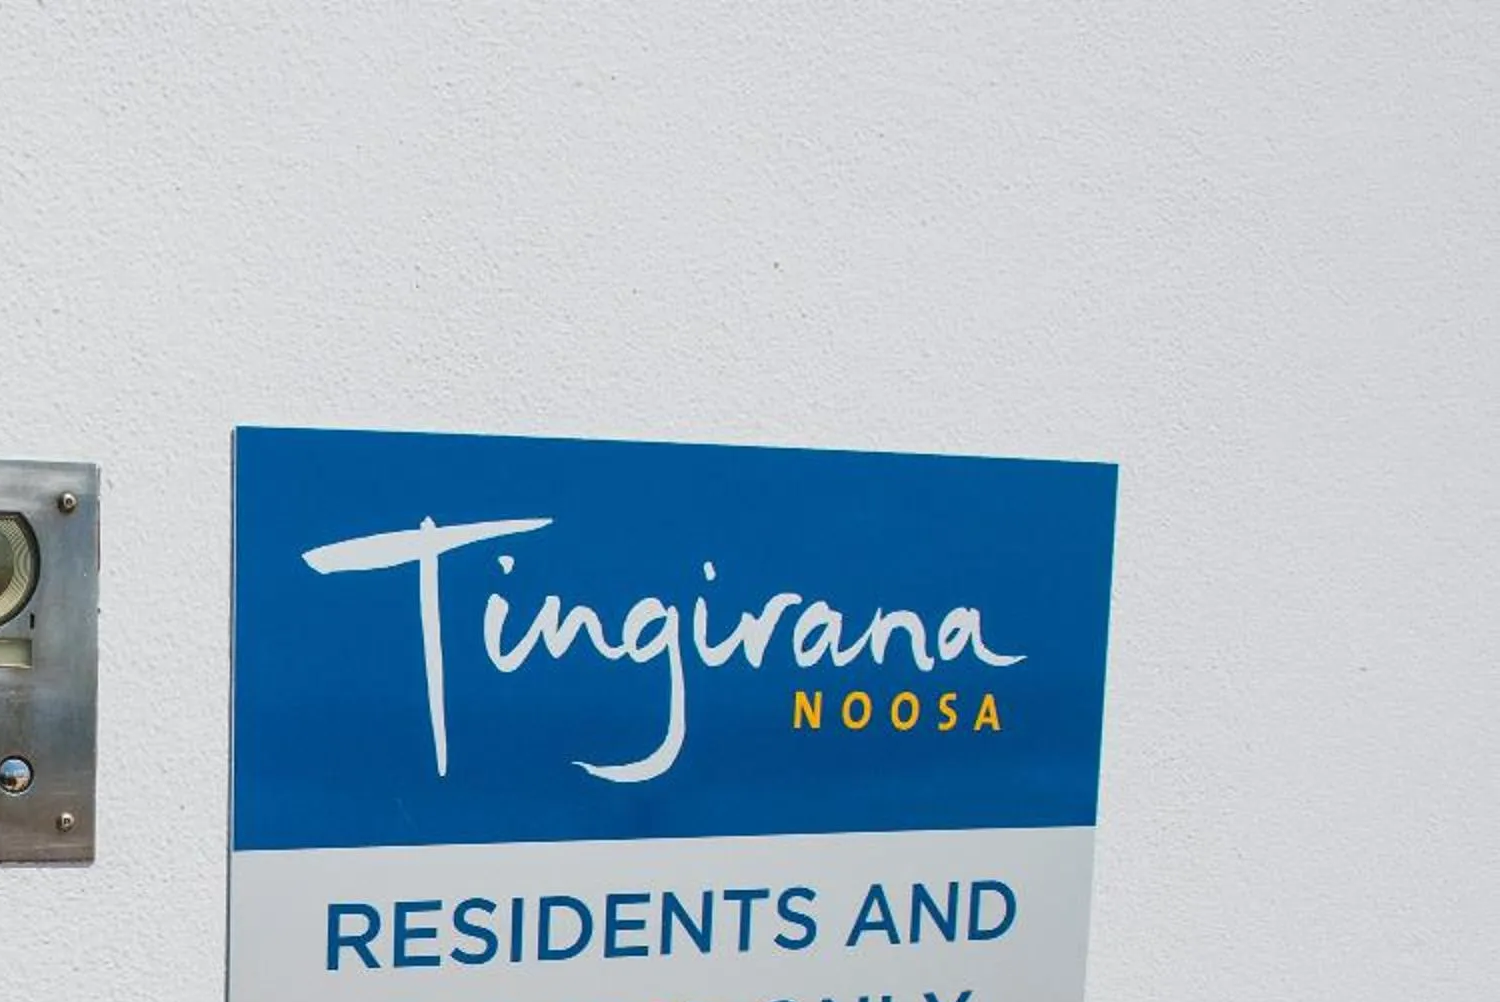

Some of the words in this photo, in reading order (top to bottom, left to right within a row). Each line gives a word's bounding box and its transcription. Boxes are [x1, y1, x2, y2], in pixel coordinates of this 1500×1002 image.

[301, 516, 1028, 783] Tingirana
[792, 690, 1002, 732] NOOSA
[326, 886, 817, 971] RESIDENTS
[845, 879, 1017, 947] AND
